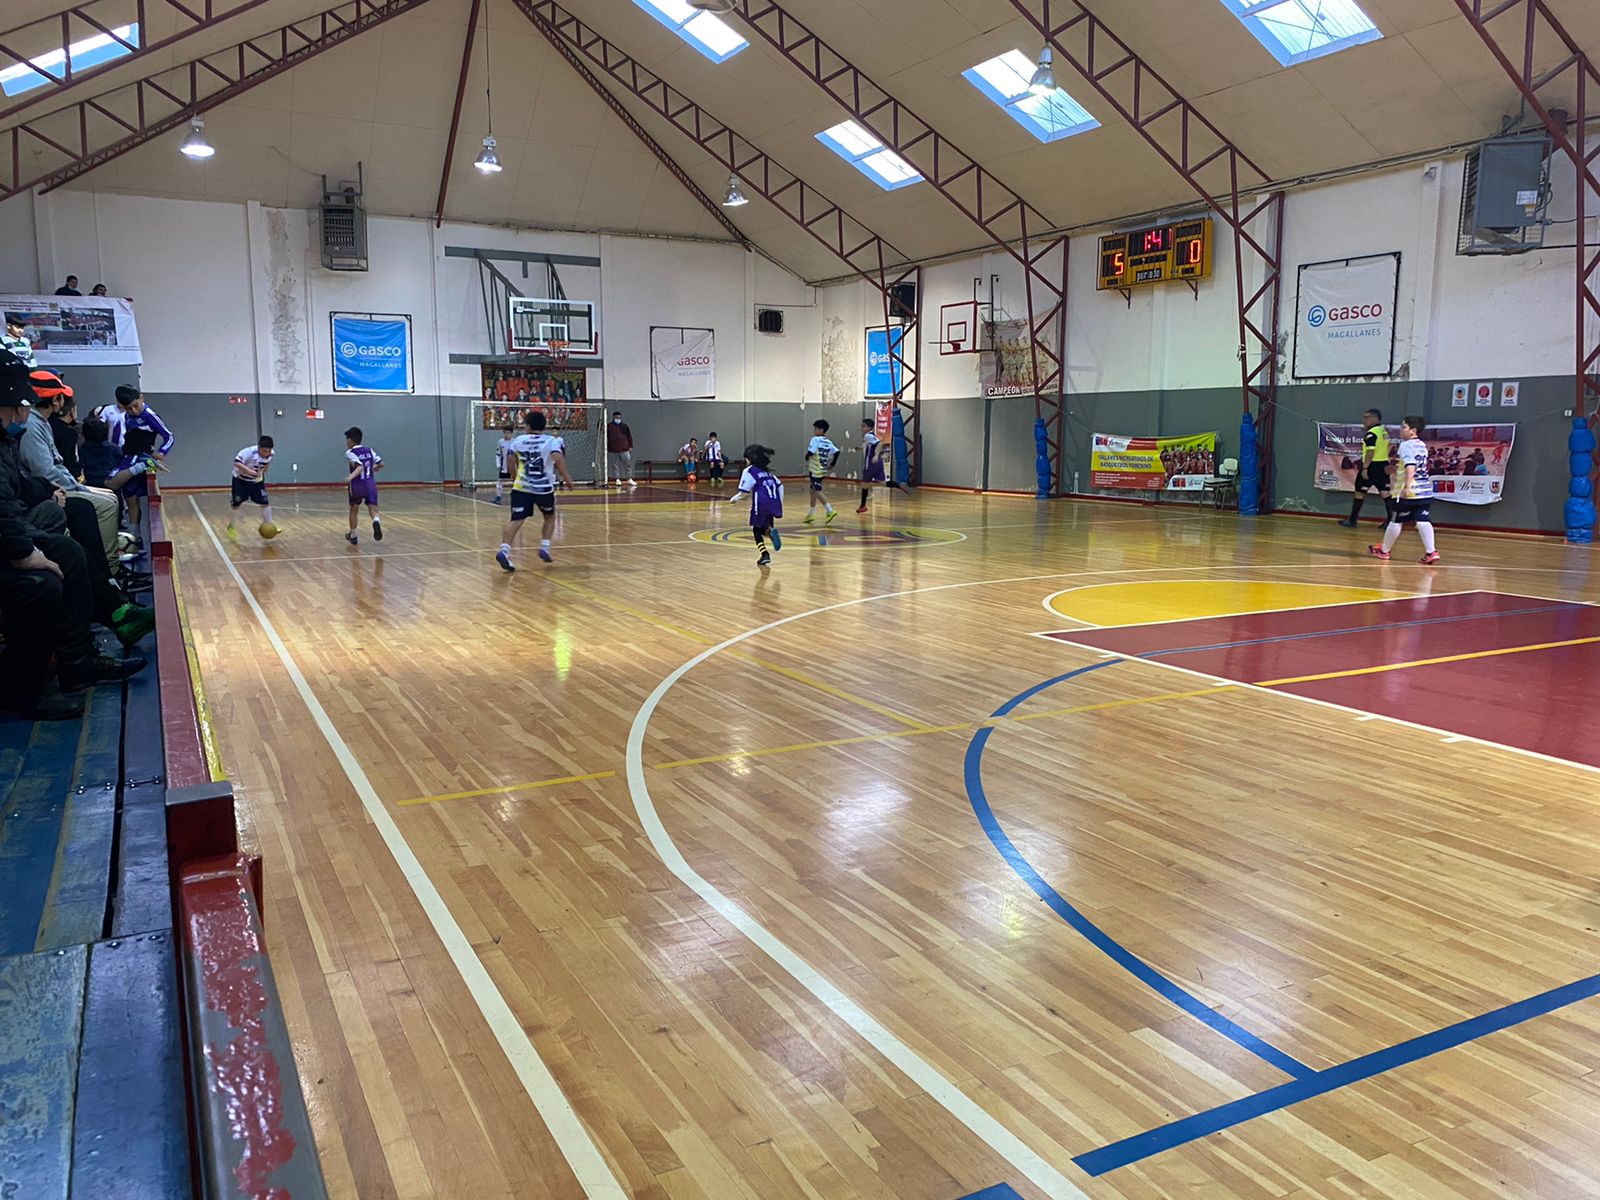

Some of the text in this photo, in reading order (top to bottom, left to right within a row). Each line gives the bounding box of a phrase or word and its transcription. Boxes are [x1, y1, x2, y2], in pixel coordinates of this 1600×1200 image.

[1190, 239, 1201, 263] 0
[1114, 253, 1124, 275] 5
[1328, 328, 1381, 339] MAGALLANES
